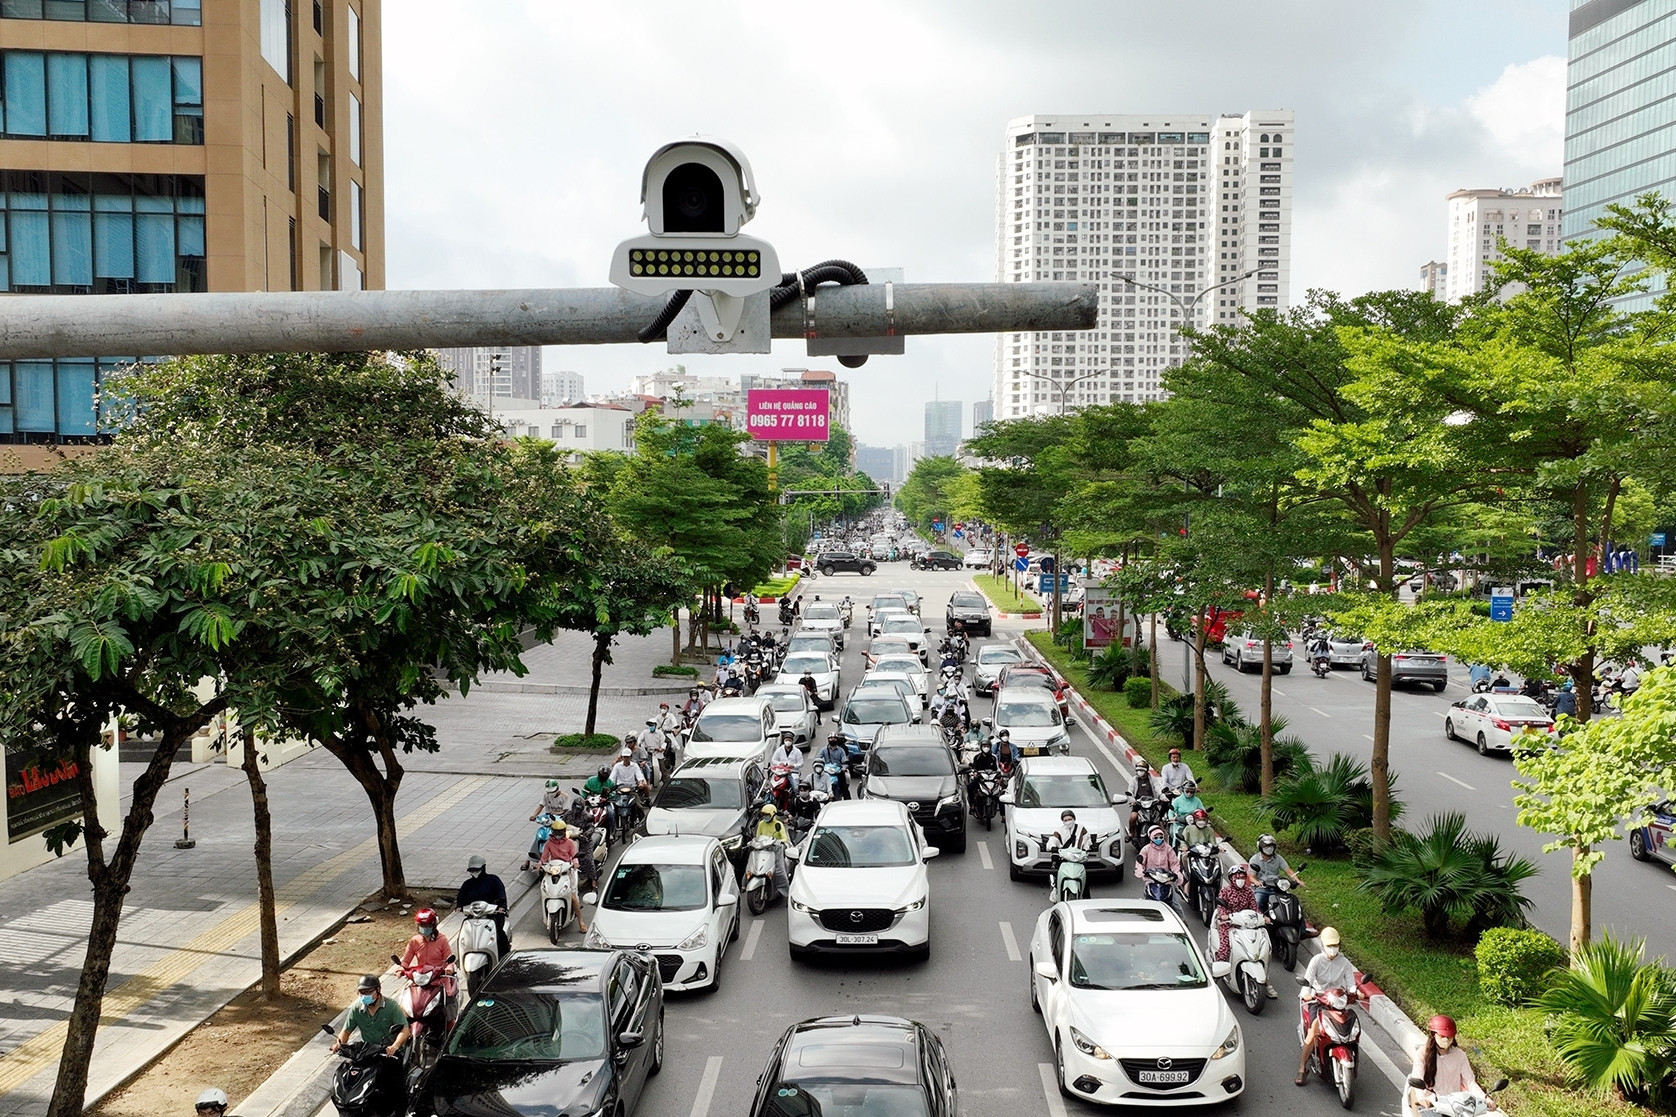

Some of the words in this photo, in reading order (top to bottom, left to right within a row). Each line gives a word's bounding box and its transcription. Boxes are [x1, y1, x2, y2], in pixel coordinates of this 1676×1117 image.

[759, 401, 772, 410] LIÊN
[773, 401, 782, 411] HỆ
[782, 400, 803, 410] QUẢNG
[804, 401, 817, 410] CÁO
[750, 414, 777, 427] 0965
[780, 414, 795, 427] 77
[797, 414, 825, 427] 8118
[1141, 1072, 1188, 1082] 30A-699.92
